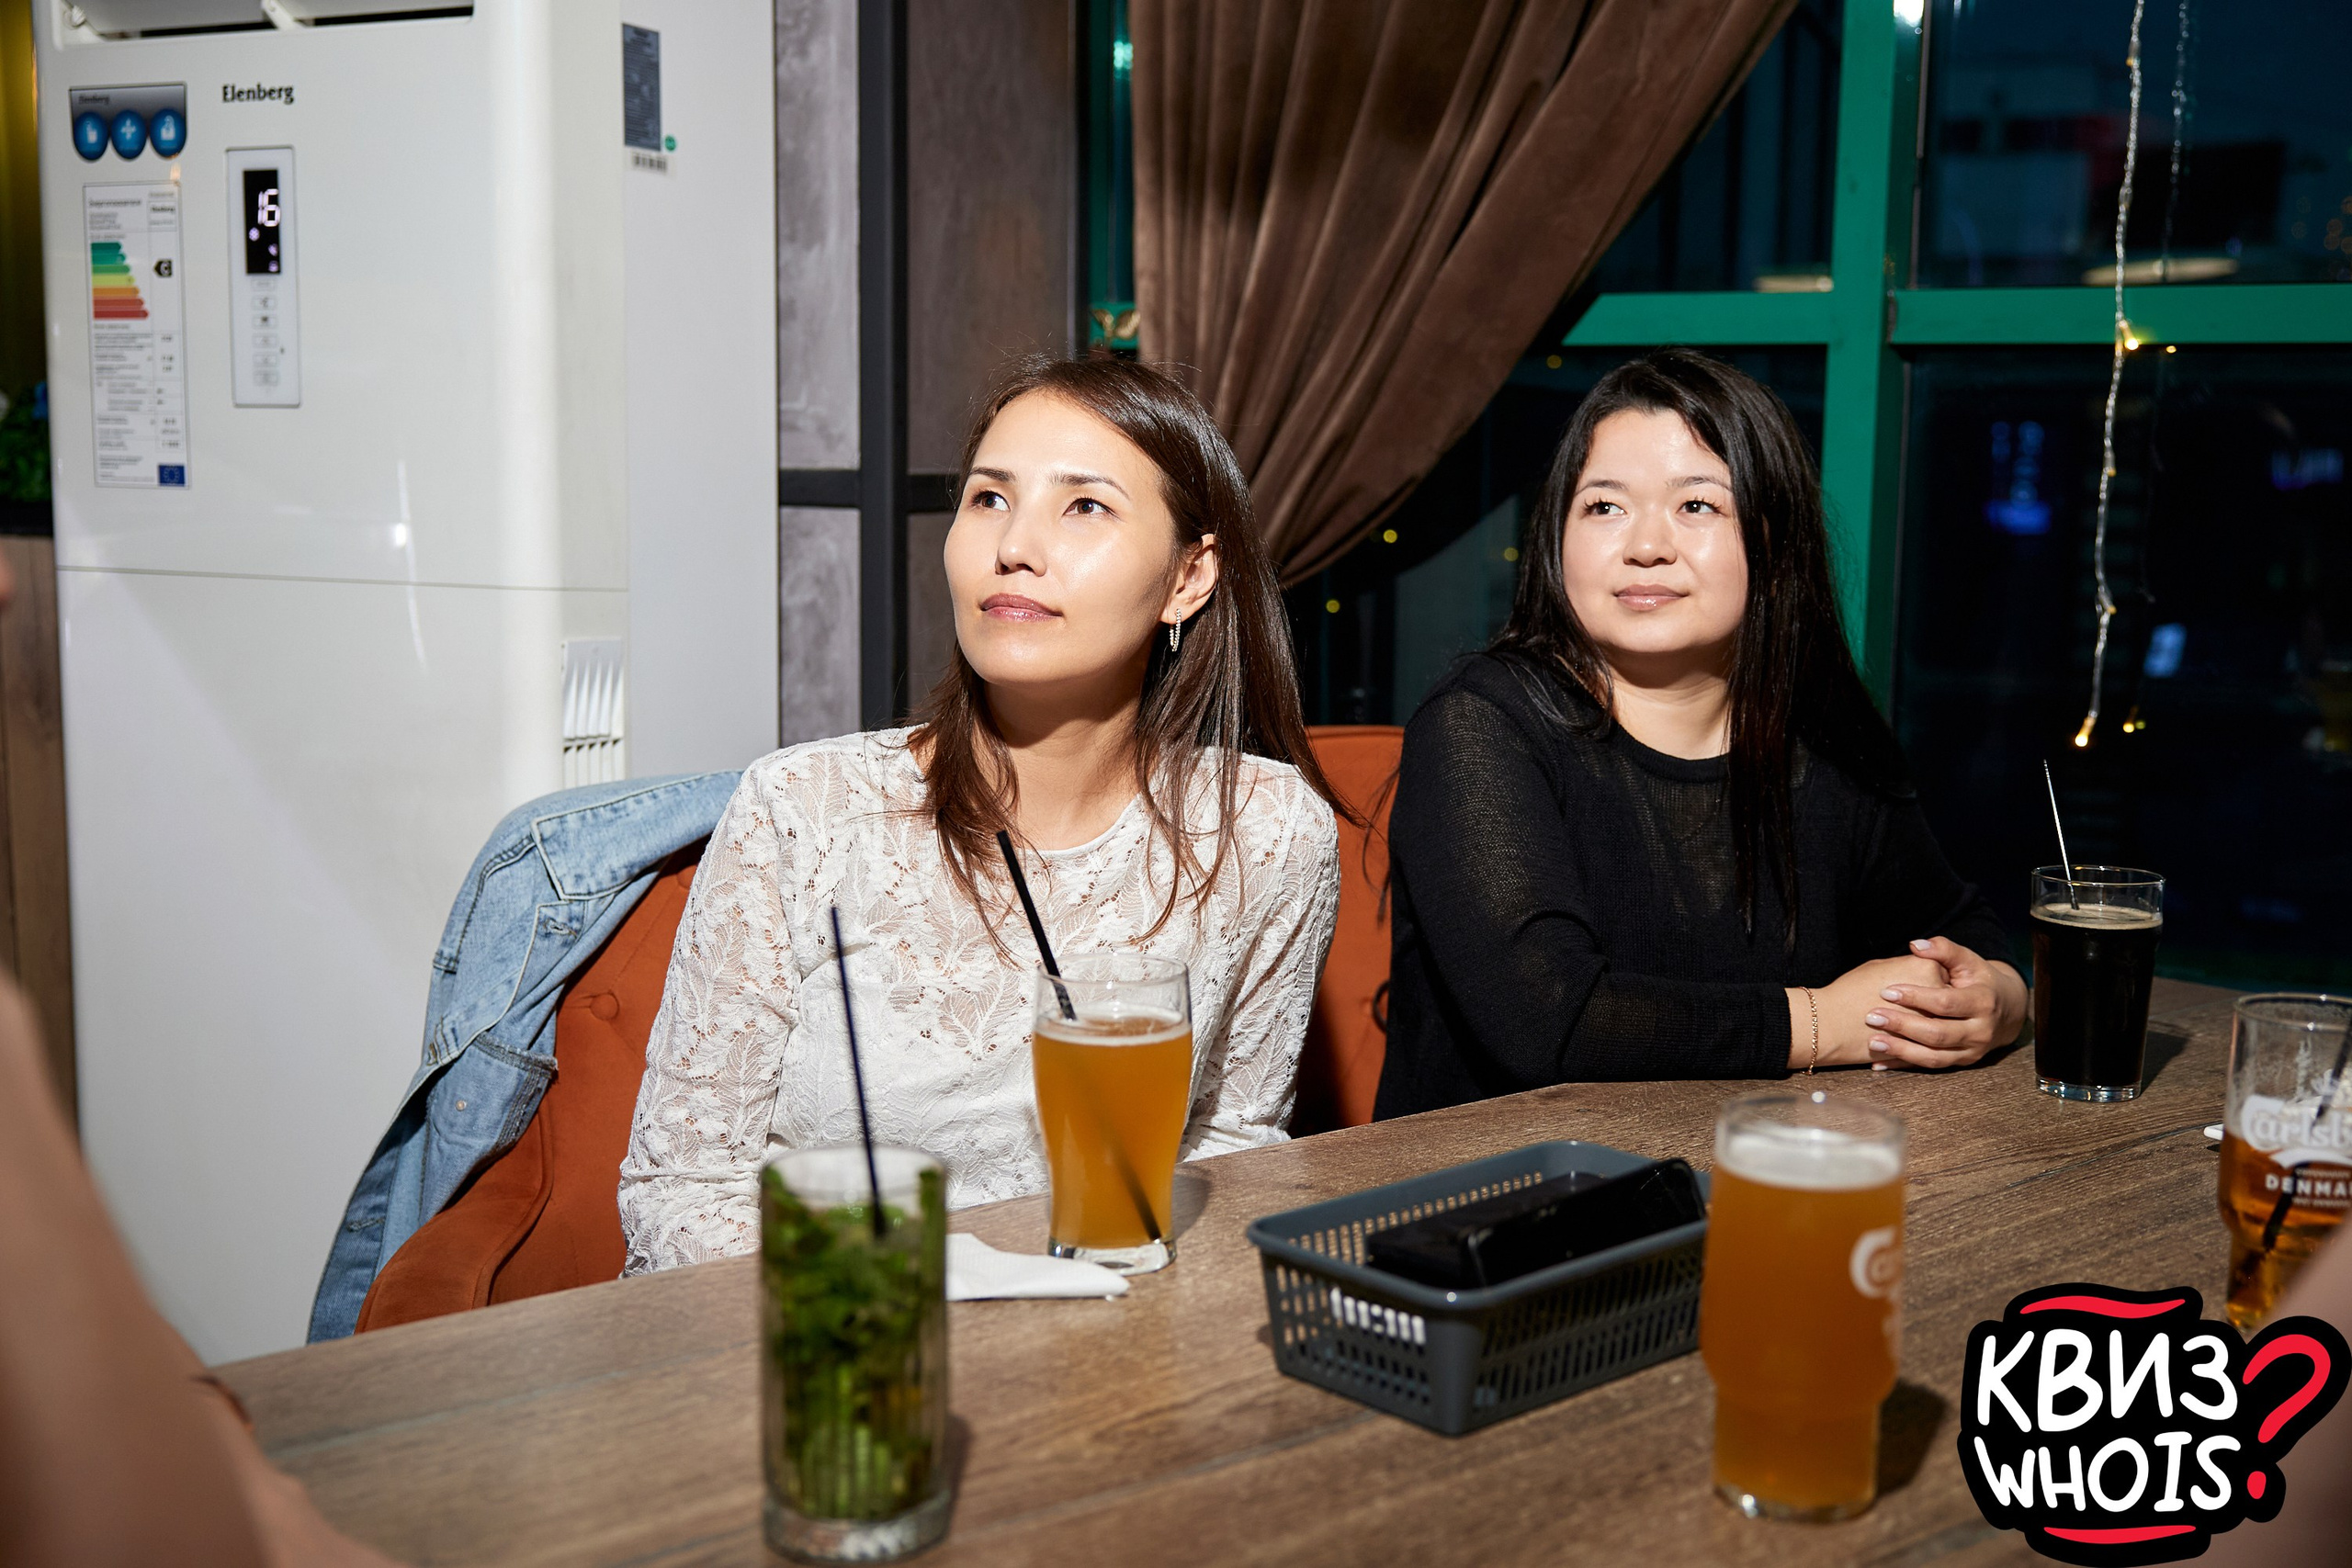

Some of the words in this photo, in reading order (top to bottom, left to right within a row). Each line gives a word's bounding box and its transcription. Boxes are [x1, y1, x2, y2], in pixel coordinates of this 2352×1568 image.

[222, 83, 295, 104] Elenberg
[257, 188, 281, 228] 16
[2265, 1173, 2352, 1196] DENMA
